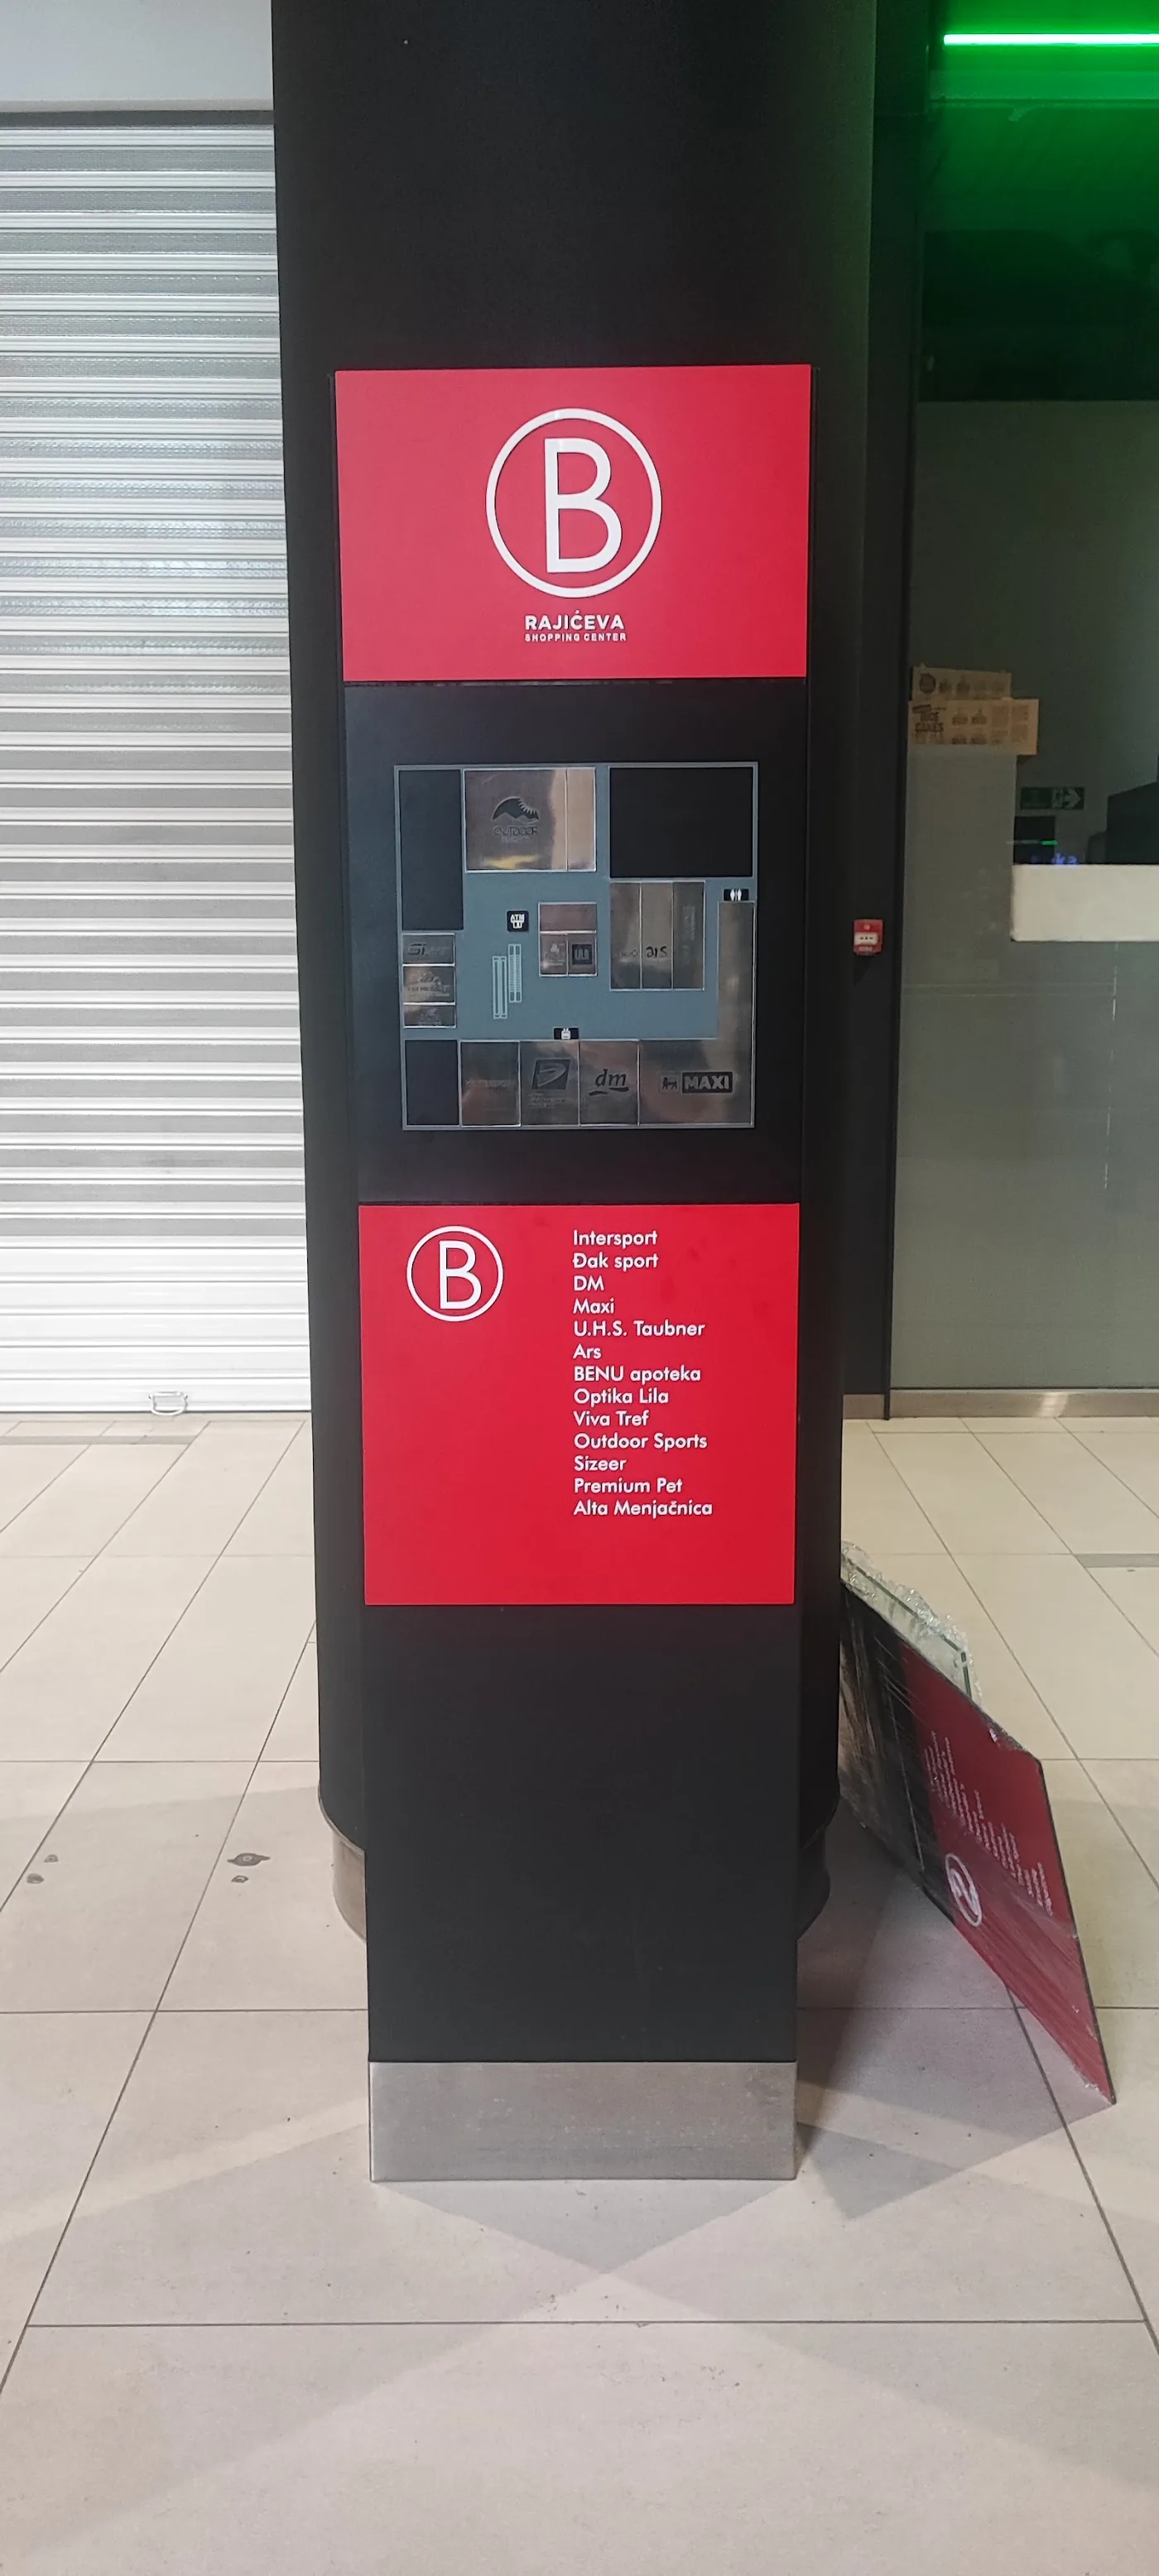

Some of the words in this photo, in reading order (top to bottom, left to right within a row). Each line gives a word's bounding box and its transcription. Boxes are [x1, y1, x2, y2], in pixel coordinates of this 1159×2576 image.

[543, 437, 623, 574] B
[525, 609, 625, 629] RAJIĆEVA
[525, 632, 580, 642] SHOPPING
[584, 632, 628, 642] CENTER
[510, 913, 525, 922] ATM
[595, 1069, 627, 1087] dm
[684, 1074, 729, 1090] MAXI
[573, 1229, 658, 1250] Intersport
[573, 1252, 608, 1269] Đak
[613, 1253, 659, 1272] sport
[439, 1240, 482, 1310] B
[574, 1275, 604, 1291] DM
[573, 1297, 614, 1314] Maxi
[574, 1320, 628, 1337] U.H.S.
[632, 1319, 706, 1336] Taubner
[573, 1343, 602, 1359] Ars
[574, 1365, 624, 1382] BENU
[630, 1364, 701, 1386] apoteka
[574, 1387, 633, 1408] Optika
[639, 1387, 669, 1404] Lila
[573, 1410, 610, 1426] Viva
[615, 1409, 650, 1426] Tref
[574, 1432, 649, 1449] Outdoor
[653, 1432, 708, 1453] Sports
[574, 1455, 627, 1472] Sizeer
[574, 1477, 651, 1493] Premium
[656, 1477, 683, 1493] Pet
[573, 1499, 608, 1516] Alta
[613, 1499, 713, 1519] Menjačnica
